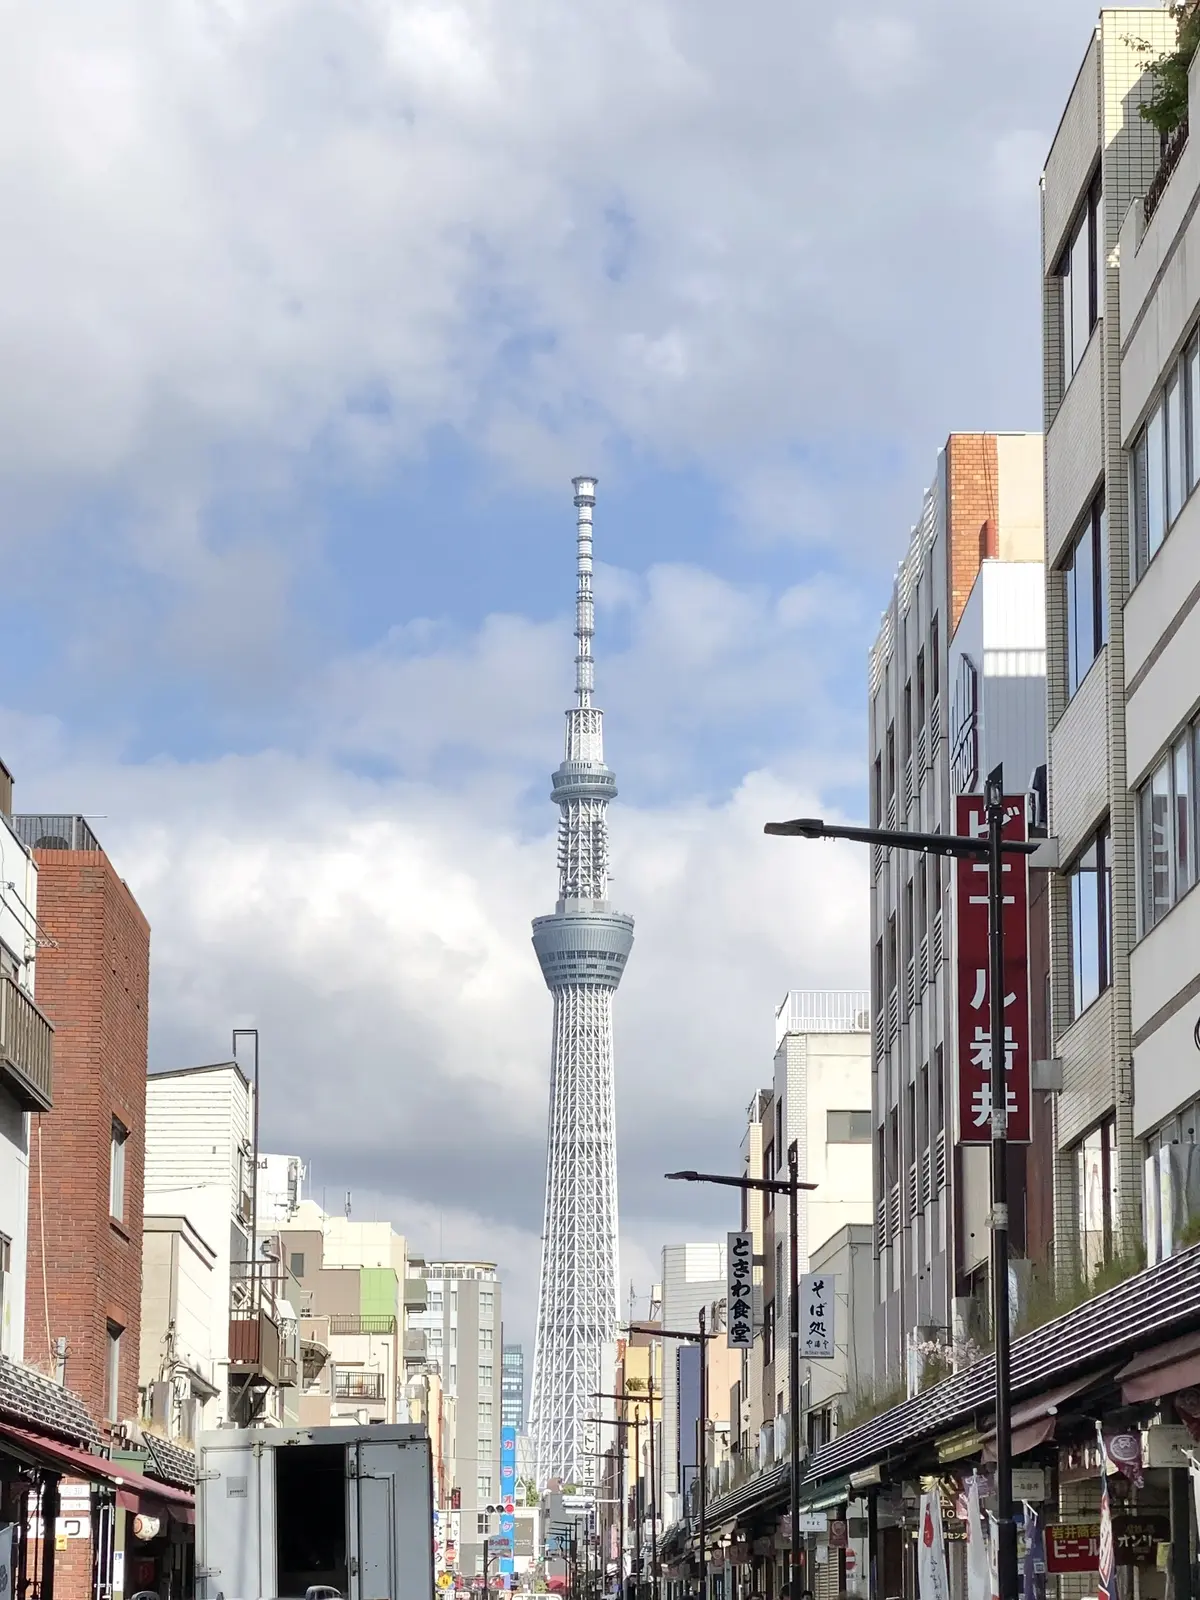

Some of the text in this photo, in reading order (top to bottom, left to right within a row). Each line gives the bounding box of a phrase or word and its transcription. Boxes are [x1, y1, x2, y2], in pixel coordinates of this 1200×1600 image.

[969, 806, 1020, 1128] ビニル岩井
[729, 1237, 751, 1343] ときわ食堂
[809, 1280, 829, 1337] そば処
[503, 1439, 514, 1532] カラオケ
[1052, 1525, 1100, 1539] 岩井商会
[1053, 1538, 1101, 1558] ビニール
[1117, 1534, 1165, 1547] オンリー
